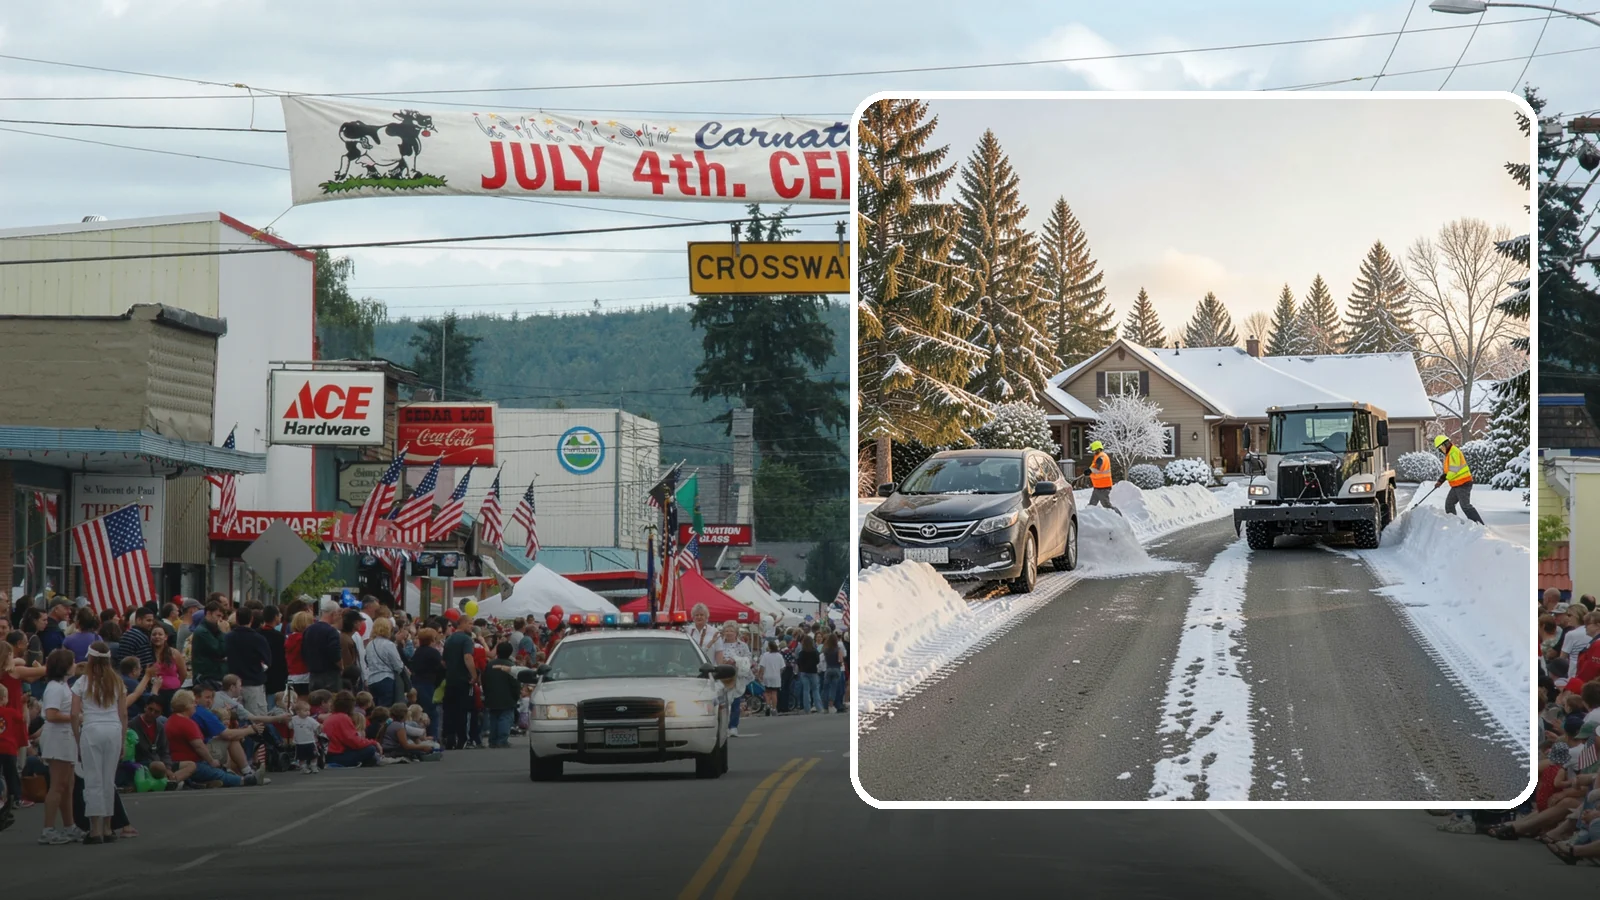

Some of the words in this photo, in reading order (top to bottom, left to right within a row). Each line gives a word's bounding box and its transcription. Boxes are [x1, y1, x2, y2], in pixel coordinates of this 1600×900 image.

[694, 121, 850, 150] Carnat
[481, 141, 605, 192] JULY
[632, 150, 746, 198] 4th.
[696, 253, 850, 280] CROSSWA
[283, 379, 374, 420] ACE
[405, 409, 452, 422] CEDAR
[283, 420, 371, 436] Hardware
[416, 427, 477, 447] Coca-Cola
[83, 485, 93, 494] St.
[95, 485, 124, 495] Vincent
[126, 485, 136, 495] de
[137, 486, 155, 495] Paul
[81, 502, 154, 522] THT
[688, 526, 741, 535] CRNATION
[699, 535, 730, 543] GLASS
